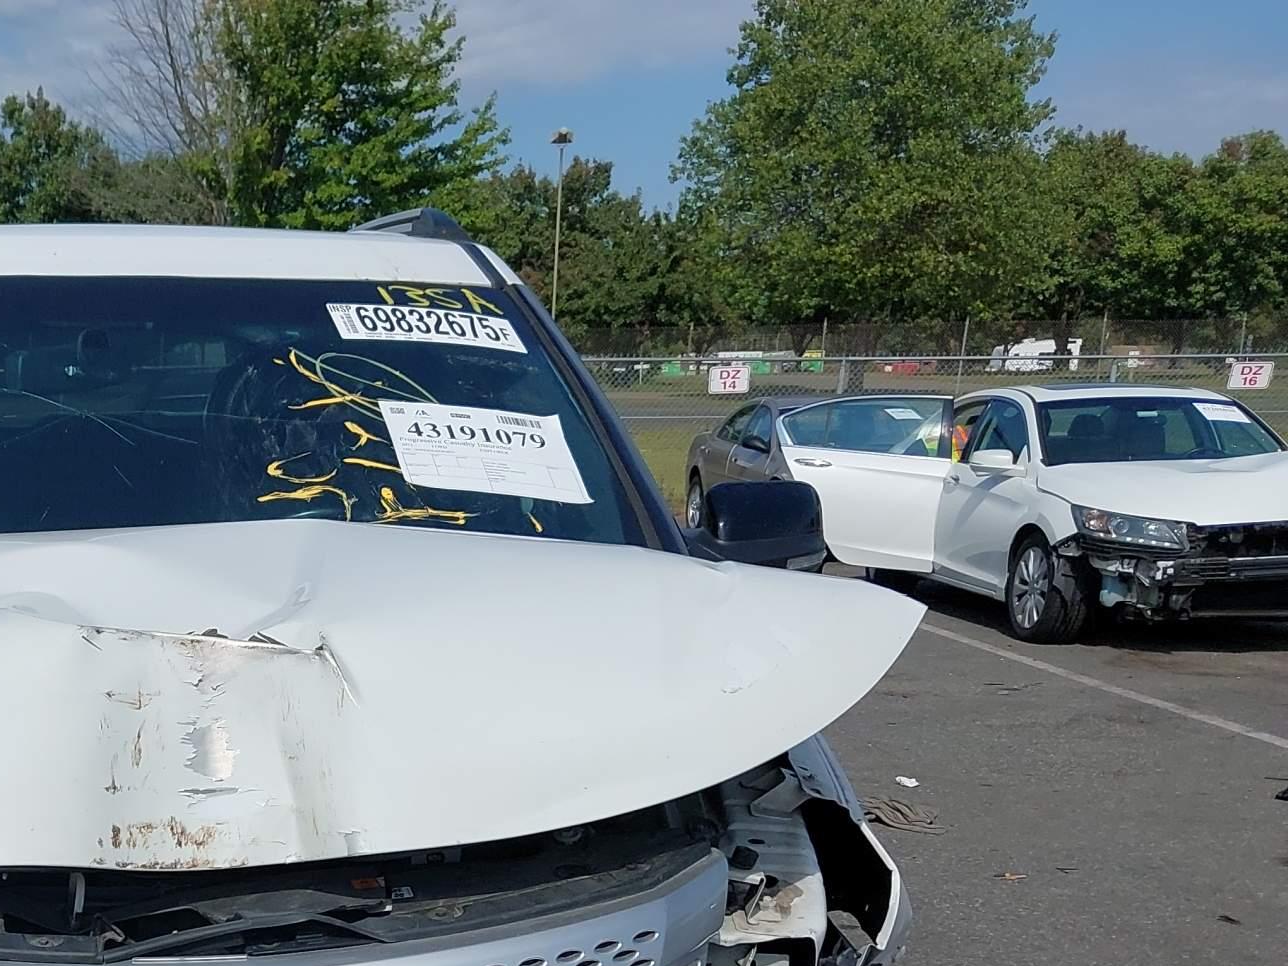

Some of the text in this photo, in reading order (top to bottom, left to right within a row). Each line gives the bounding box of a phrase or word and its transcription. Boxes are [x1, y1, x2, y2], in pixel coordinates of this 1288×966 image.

[329, 305, 352, 313] INSP
[355, 306, 501, 342] 69832675
[719, 369, 741, 380] DZ
[1240, 366, 1264, 376] DZ
[721, 380, 737, 390] 14
[1241, 376, 1258, 386] 16
[407, 422, 546, 449] 43191079
